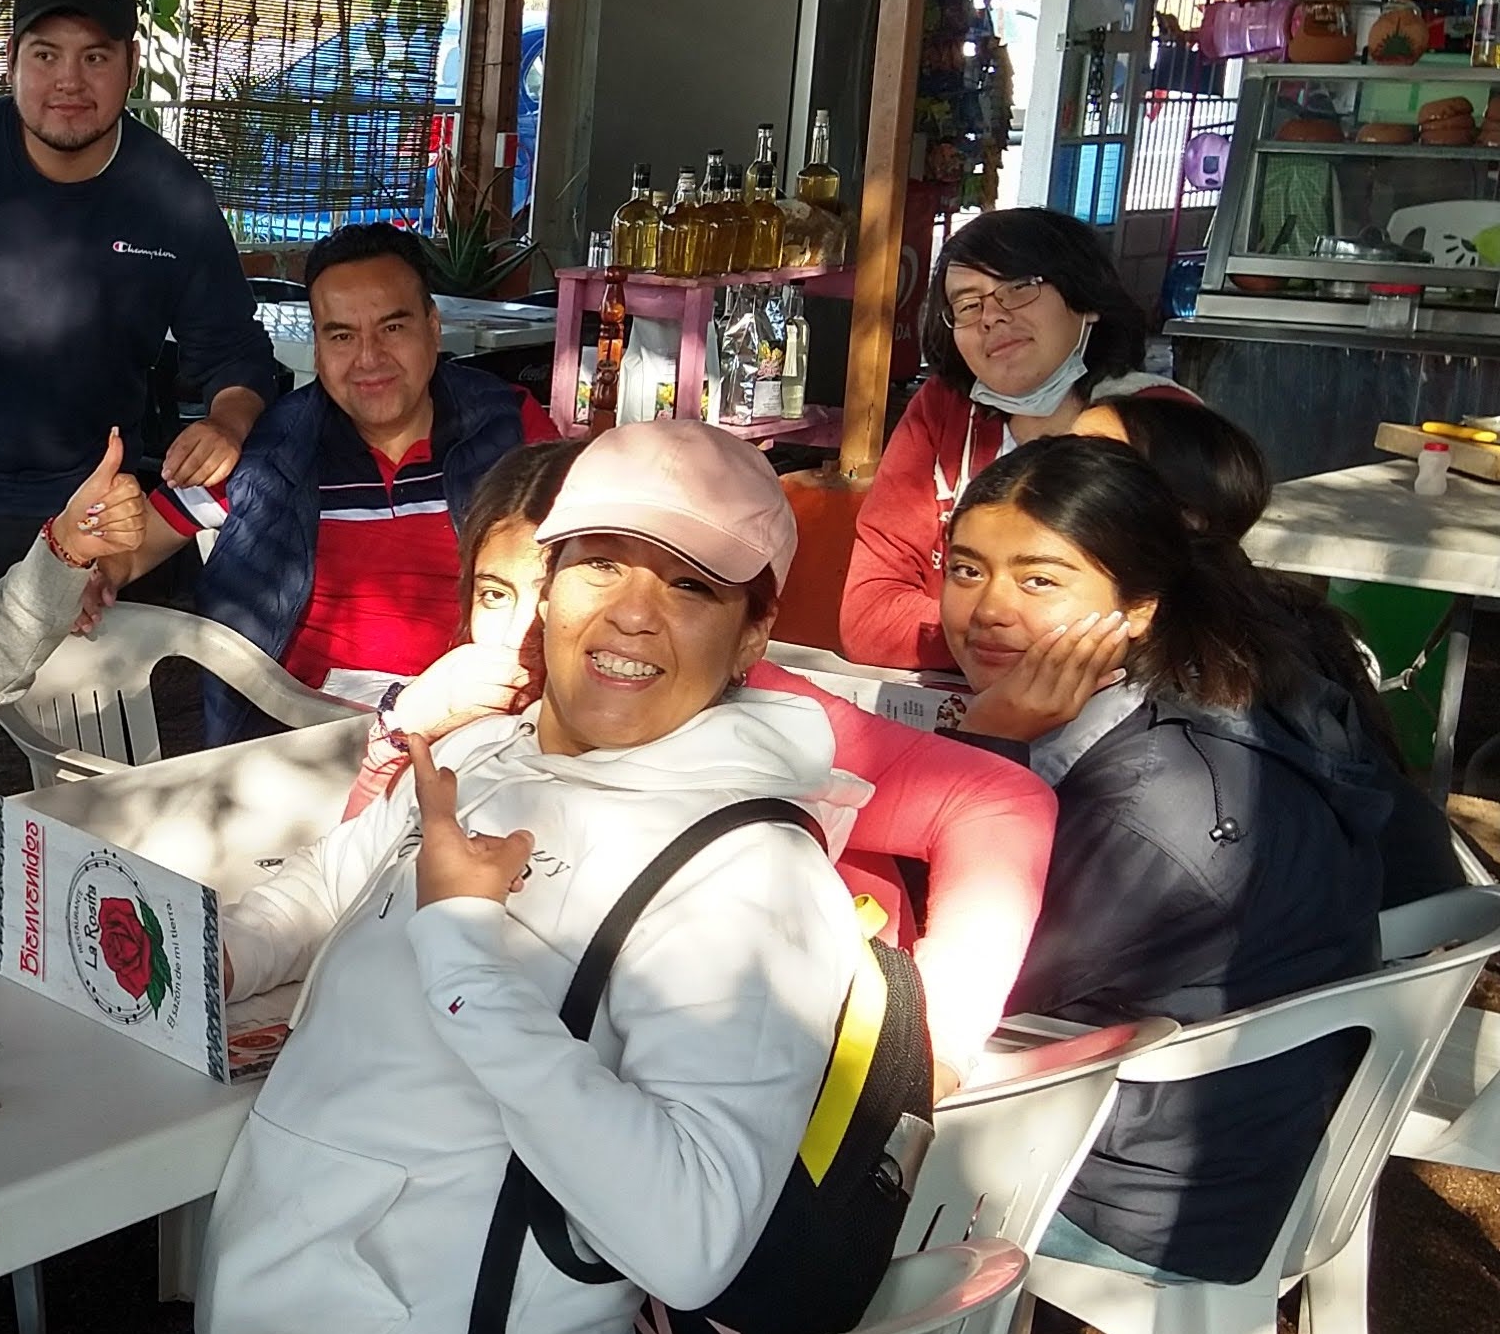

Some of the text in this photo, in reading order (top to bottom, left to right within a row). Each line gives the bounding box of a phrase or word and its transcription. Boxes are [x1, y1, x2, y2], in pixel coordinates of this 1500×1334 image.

[112, 241, 177, 260] Champion
[20, 819, 41, 976] Bienvenidos
[73, 888, 84, 954] RESTAURANTE
[84, 884, 100, 971] La Rosita
[172, 942, 181, 960] mi
[173, 962, 182, 980] de
[166, 1014, 176, 1030] El
